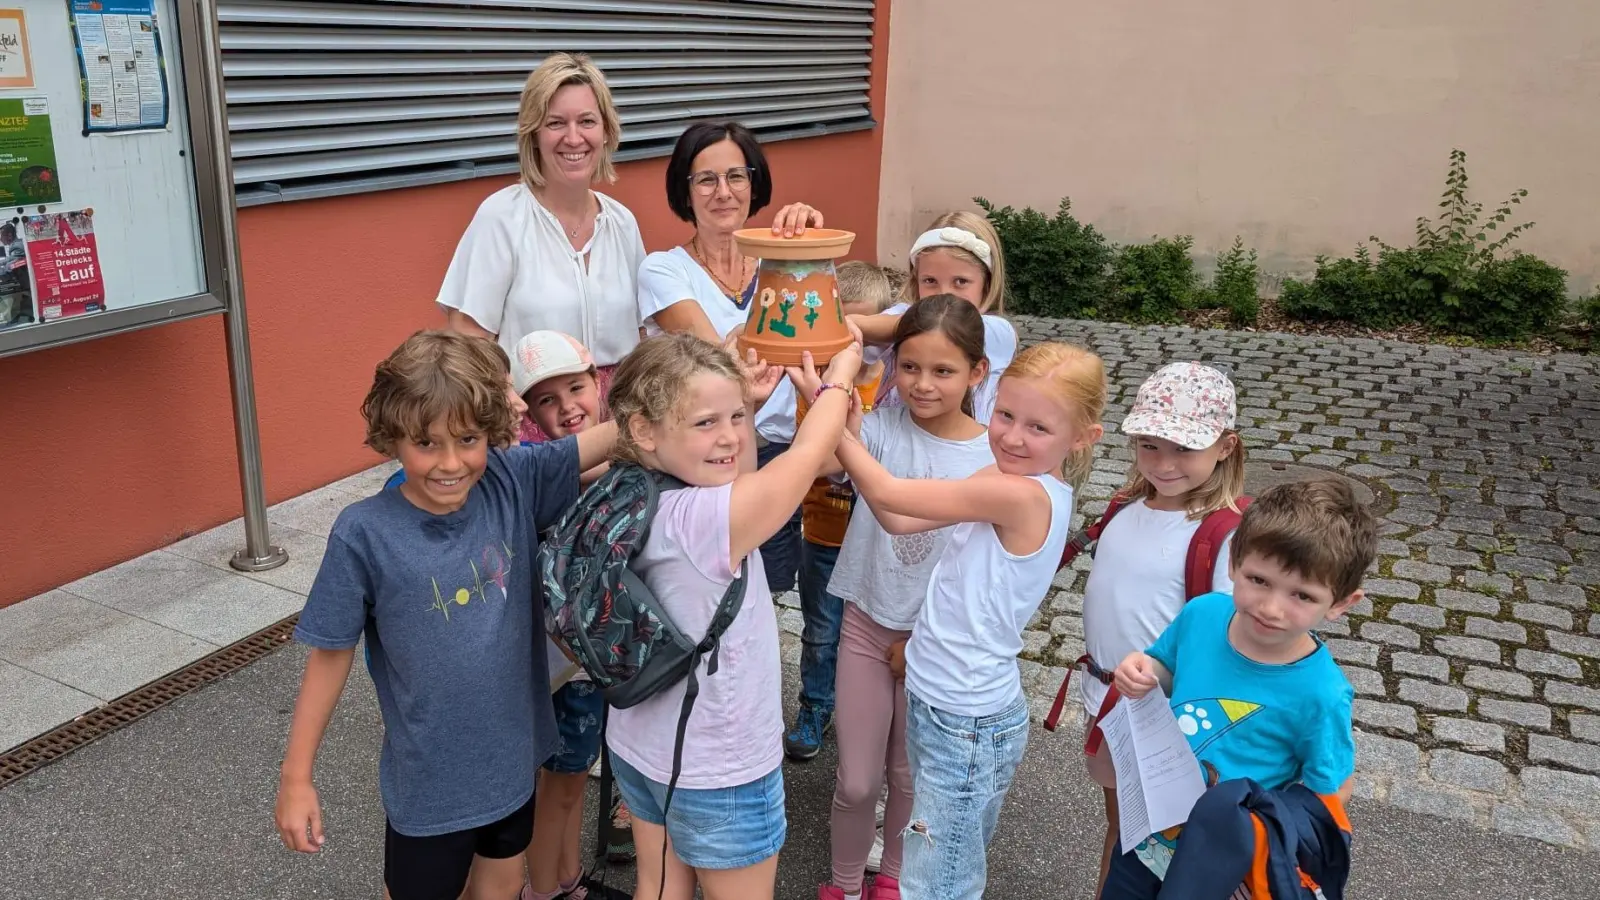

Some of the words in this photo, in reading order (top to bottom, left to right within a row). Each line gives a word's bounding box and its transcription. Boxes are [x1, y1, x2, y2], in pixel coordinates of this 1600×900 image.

[0, 33, 18, 50] feld
[55, 255, 93, 267] Dreiecks
[59, 264, 94, 283] Lauf
